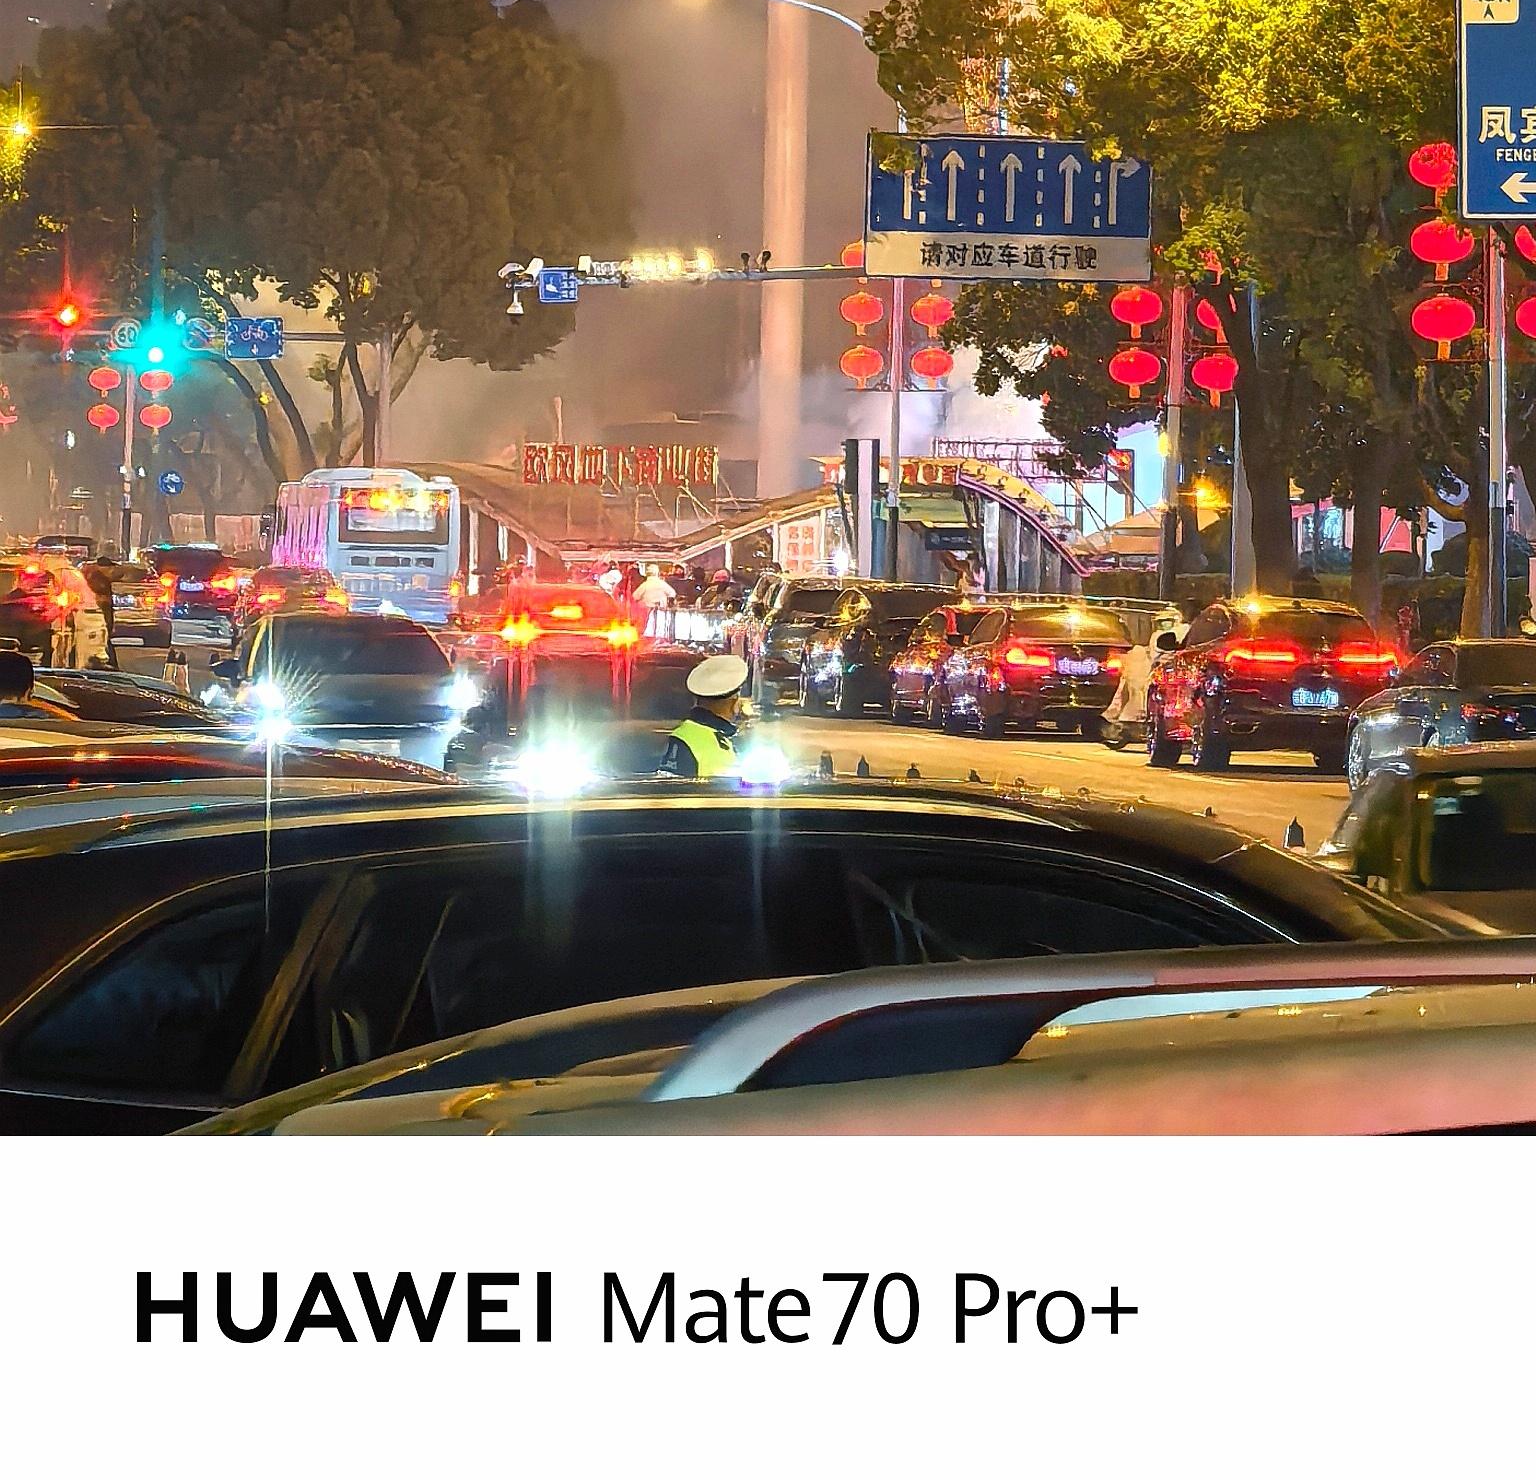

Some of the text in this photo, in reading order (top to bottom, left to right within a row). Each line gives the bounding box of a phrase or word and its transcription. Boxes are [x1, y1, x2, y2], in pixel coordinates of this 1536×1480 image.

[920, 241, 1097, 271] 请对应车道行驶
